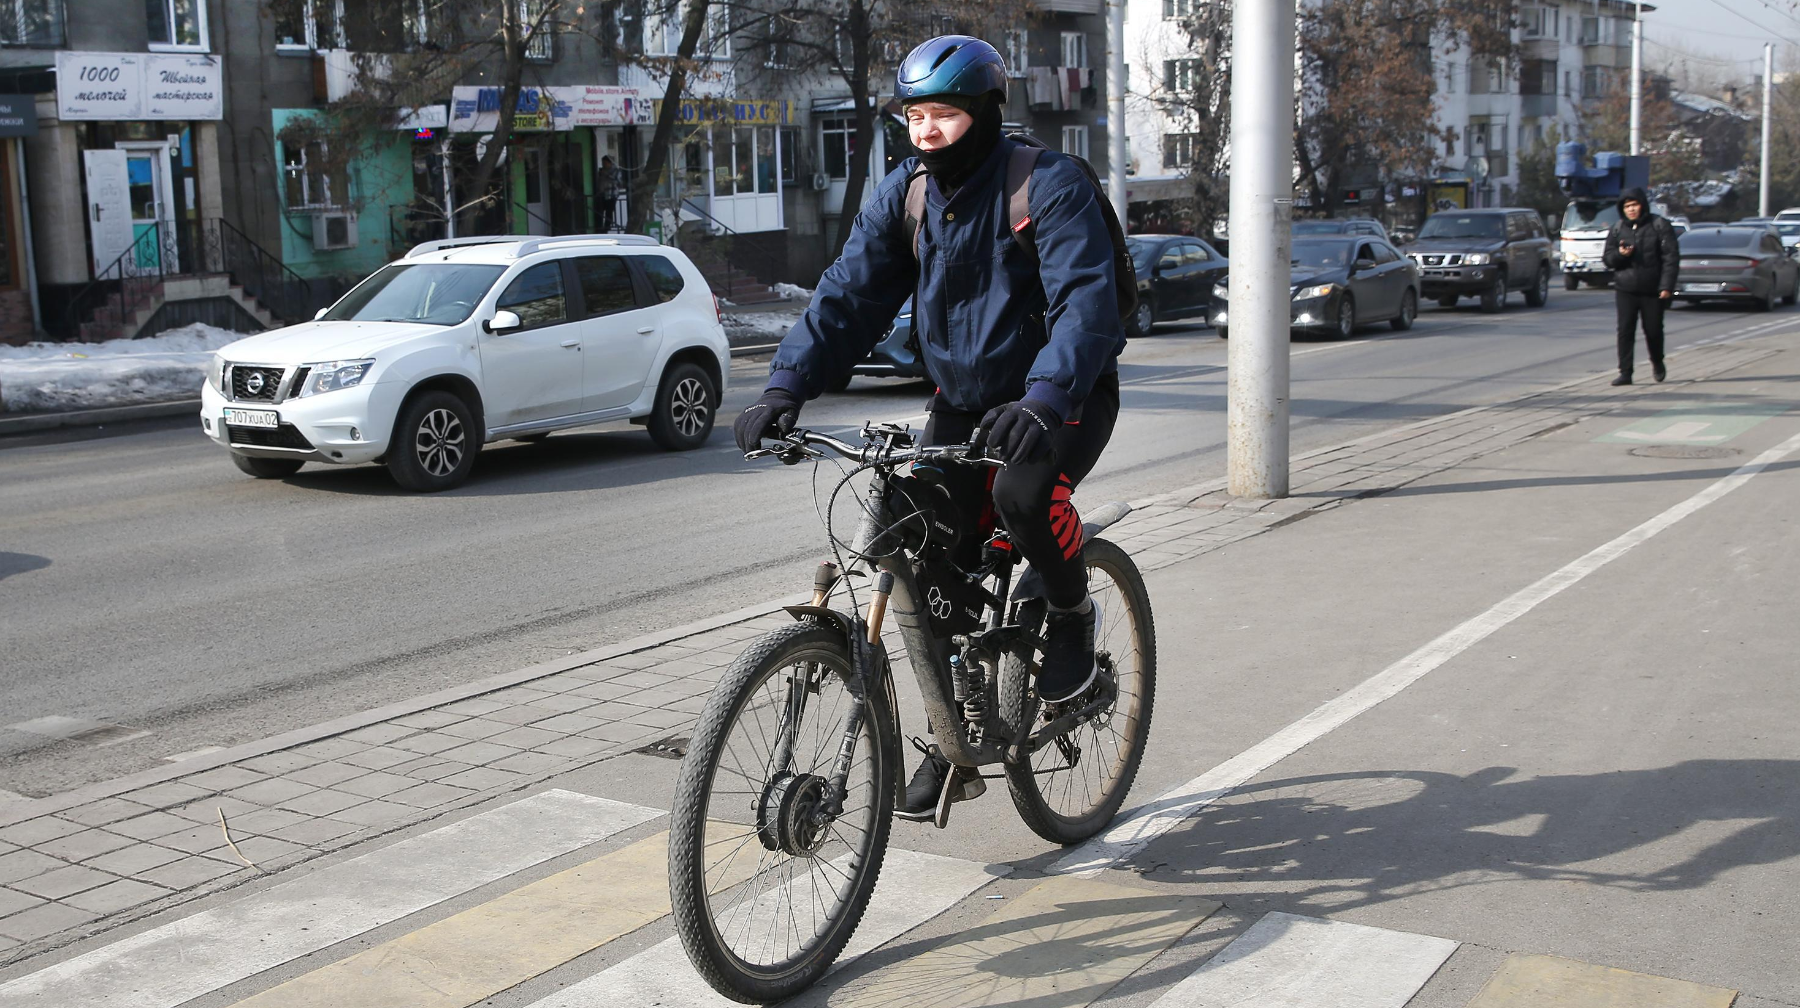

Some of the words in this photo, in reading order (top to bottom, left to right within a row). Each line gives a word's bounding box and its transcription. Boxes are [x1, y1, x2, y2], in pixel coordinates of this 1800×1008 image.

[80, 66, 120, 82] 1000
[160, 70, 207, 85] Швейная
[75, 88, 128, 101] мелочей
[152, 90, 213, 102] мастерская
